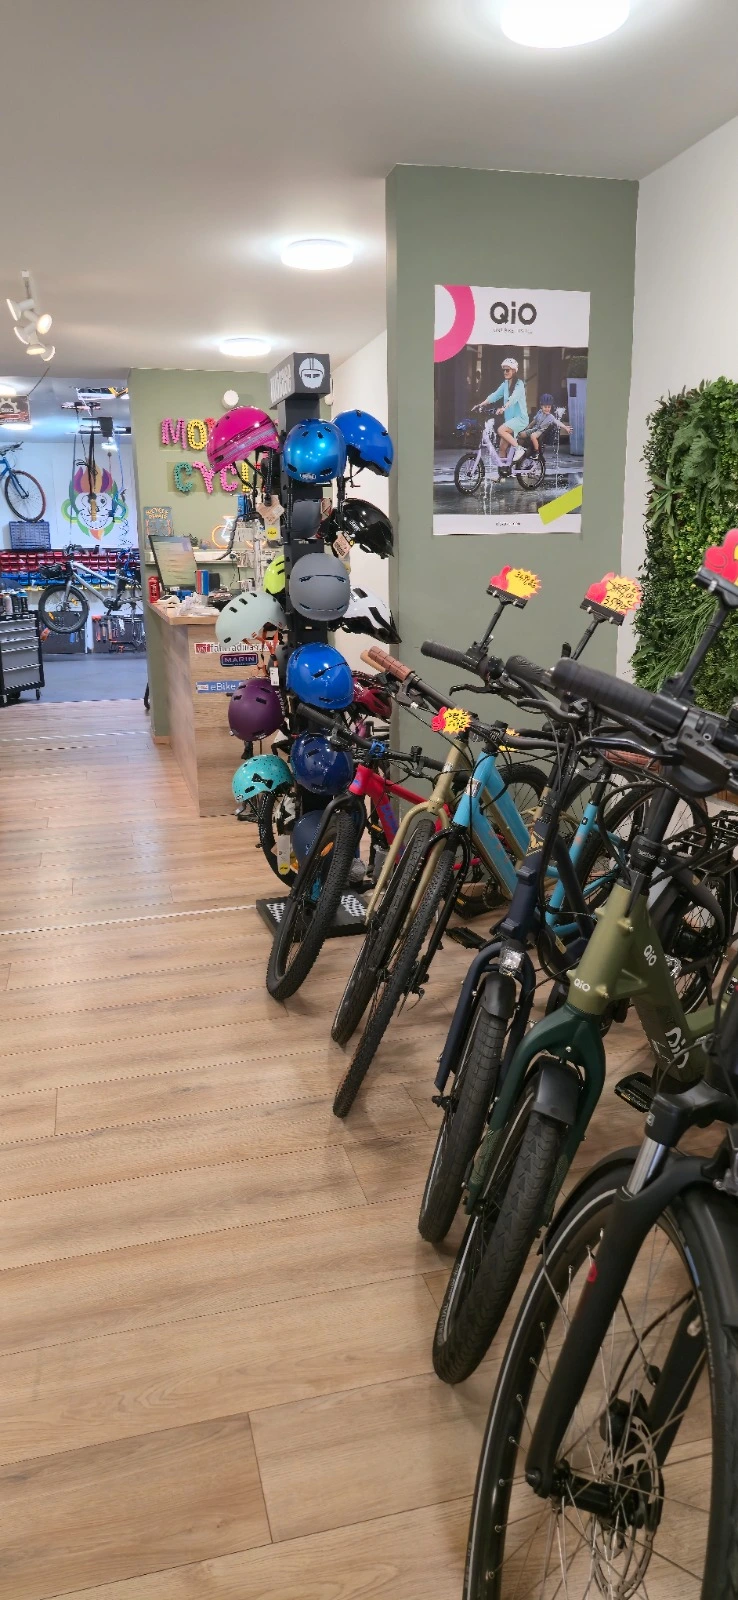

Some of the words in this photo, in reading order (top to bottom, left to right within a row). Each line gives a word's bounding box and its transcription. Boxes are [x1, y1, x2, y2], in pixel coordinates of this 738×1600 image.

[490, 301, 538, 326] QiO
[210, 682, 236, 691] eBike
[644, 944, 657, 966] QiO
[574, 978, 591, 992] QiO
